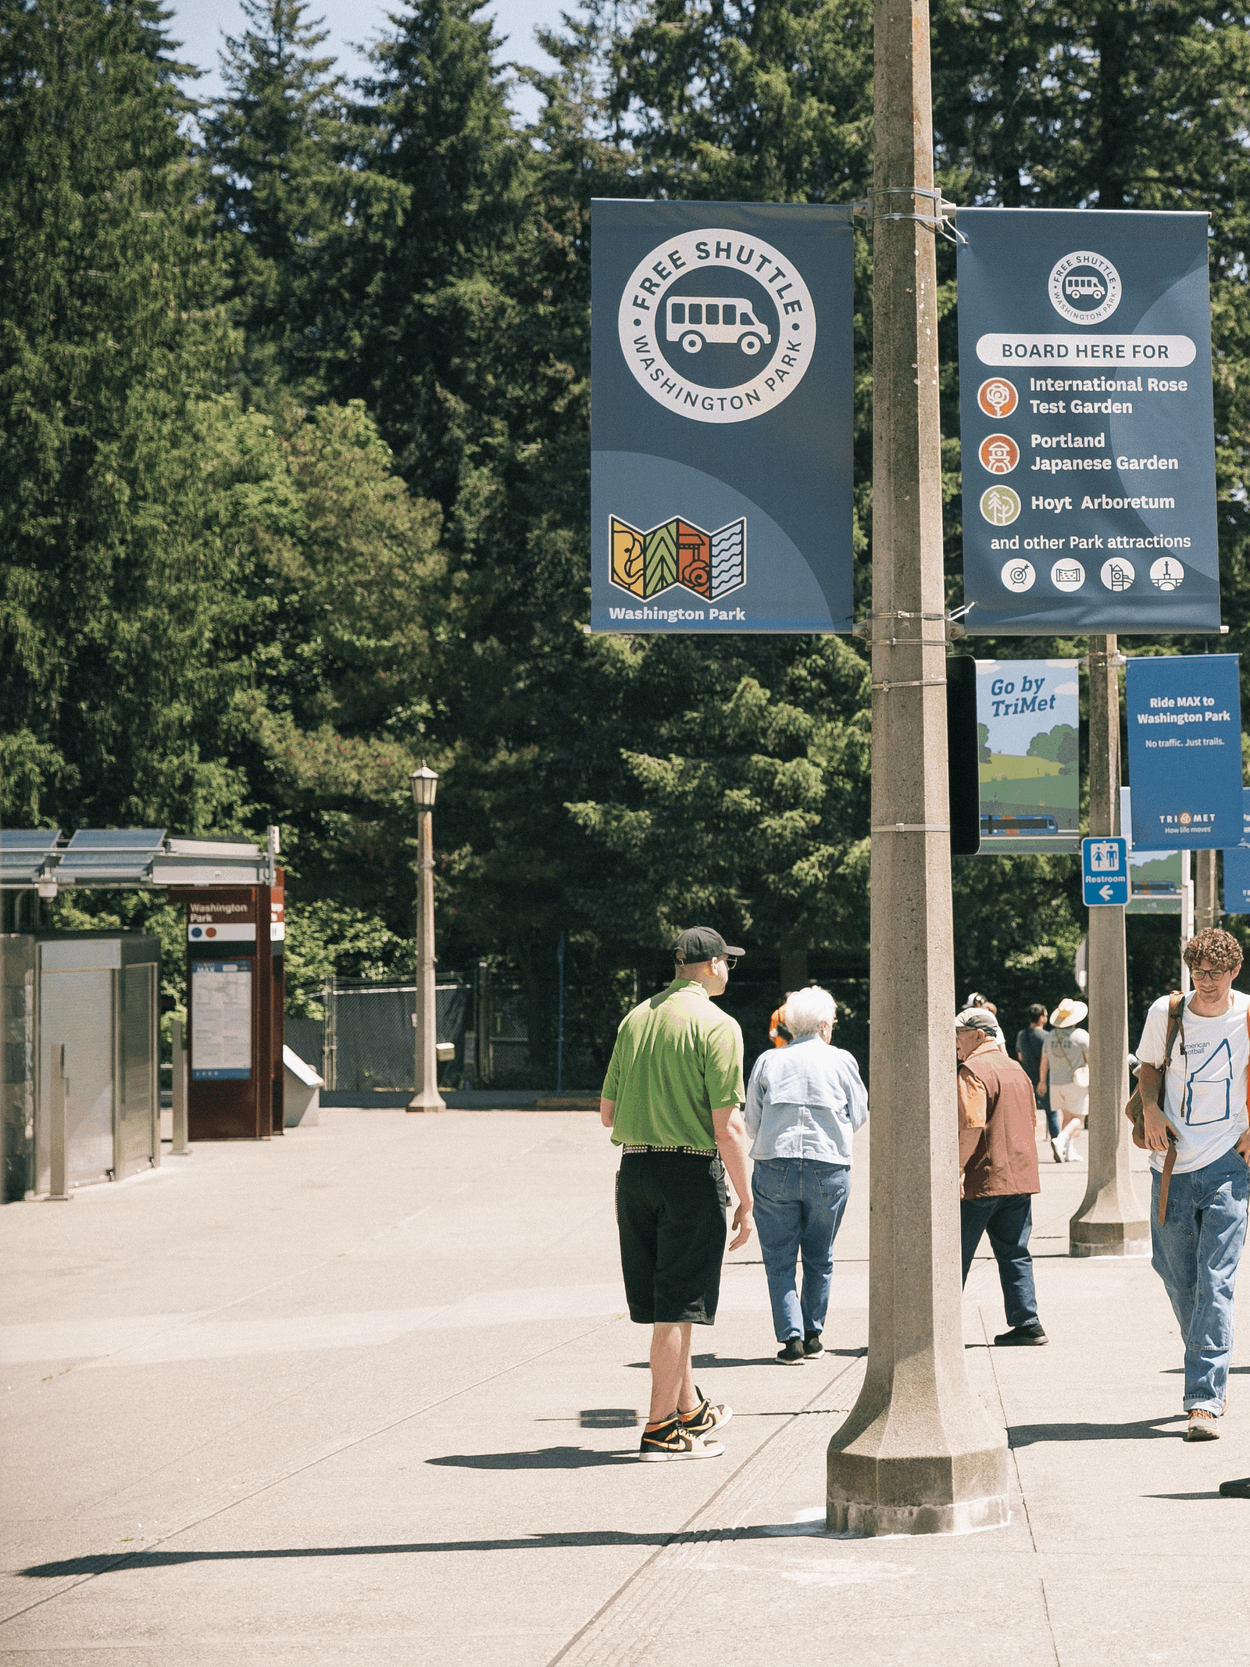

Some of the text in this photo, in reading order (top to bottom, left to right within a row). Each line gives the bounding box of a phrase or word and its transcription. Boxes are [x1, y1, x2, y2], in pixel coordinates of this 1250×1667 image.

[1053, 255, 1117, 284] FREE SHUTTLE
[632, 241, 803, 315] FREE SHUTTLE
[1053, 291, 1117, 321] WASHINGTON PARK
[1002, 343, 1169, 359] BOARD HERE FOR
[633, 335, 802, 411] WASHINGTON PARK
[1030, 376, 1188, 392] International Rose
[1029, 398, 1133, 414] Test Garden
[1031, 432, 1106, 448] Portland
[1030, 455, 1179, 474] Japanese Garden
[1031, 494, 1175, 513] Hoyt Arboretum
[990, 533, 1192, 550] and other Park attractions
[608, 606, 746, 623] Washington Park
[991, 675, 1046, 696] Go by
[991, 694, 1056, 718] TriMet
[1149, 696, 1215, 708] Ride MAX to
[1137, 710, 1231, 725] Washington Park
[1145, 736, 1225, 748] No traffic. Just trails.
[1085, 875, 1126, 883] Restroom
[190, 903, 248, 914] Washington
[190, 913, 213, 923] Park
[1184, 1041, 1210, 1049] merican
